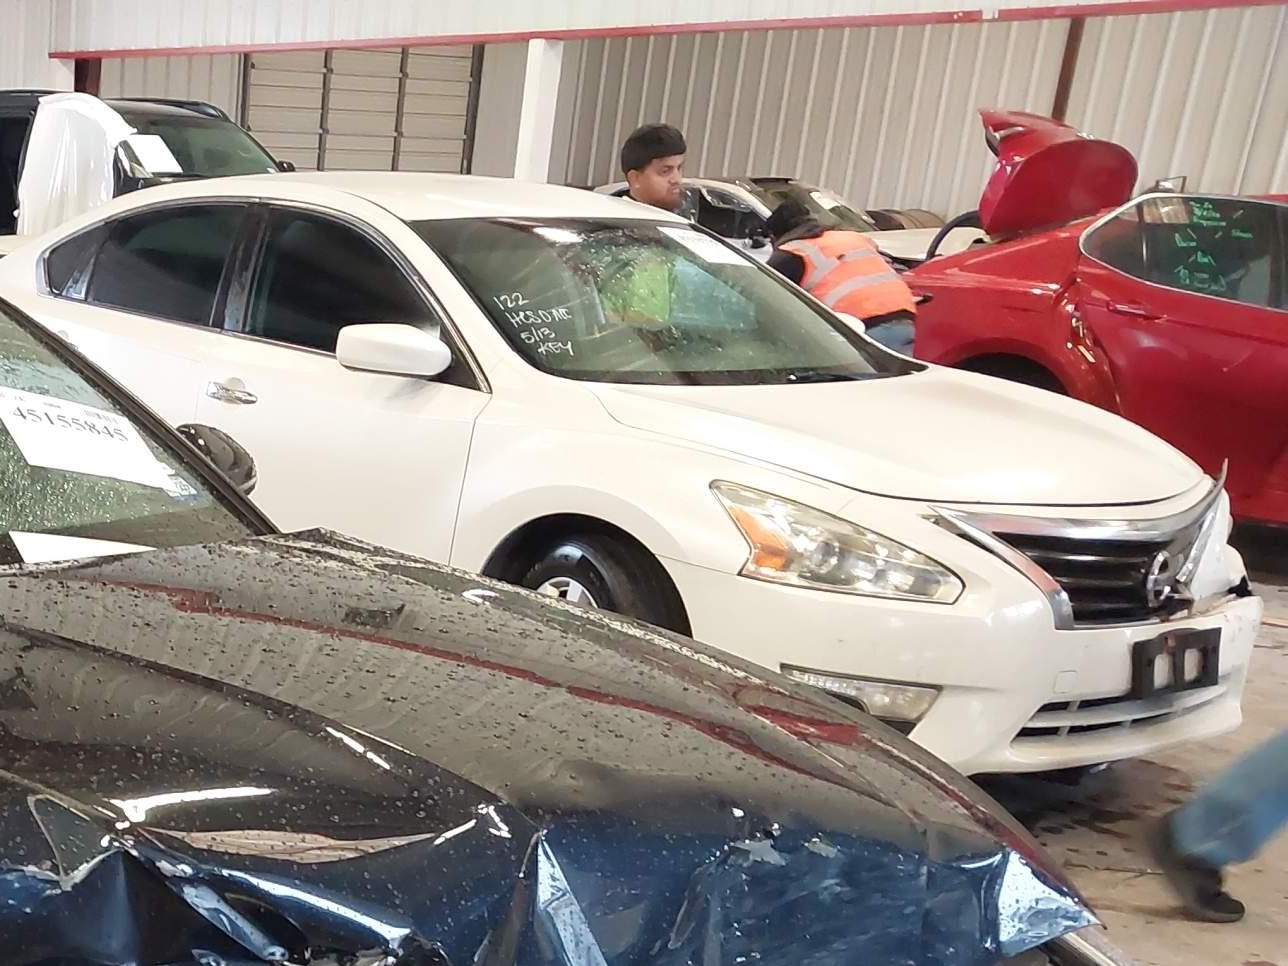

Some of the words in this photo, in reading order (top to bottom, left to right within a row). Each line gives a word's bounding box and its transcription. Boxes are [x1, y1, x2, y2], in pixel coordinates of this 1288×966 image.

[493, 292, 529, 310] 122
[520, 326, 555, 343] 5/13
[537, 341, 574, 356] KEY
[12, 406, 129, 442] 45155845
